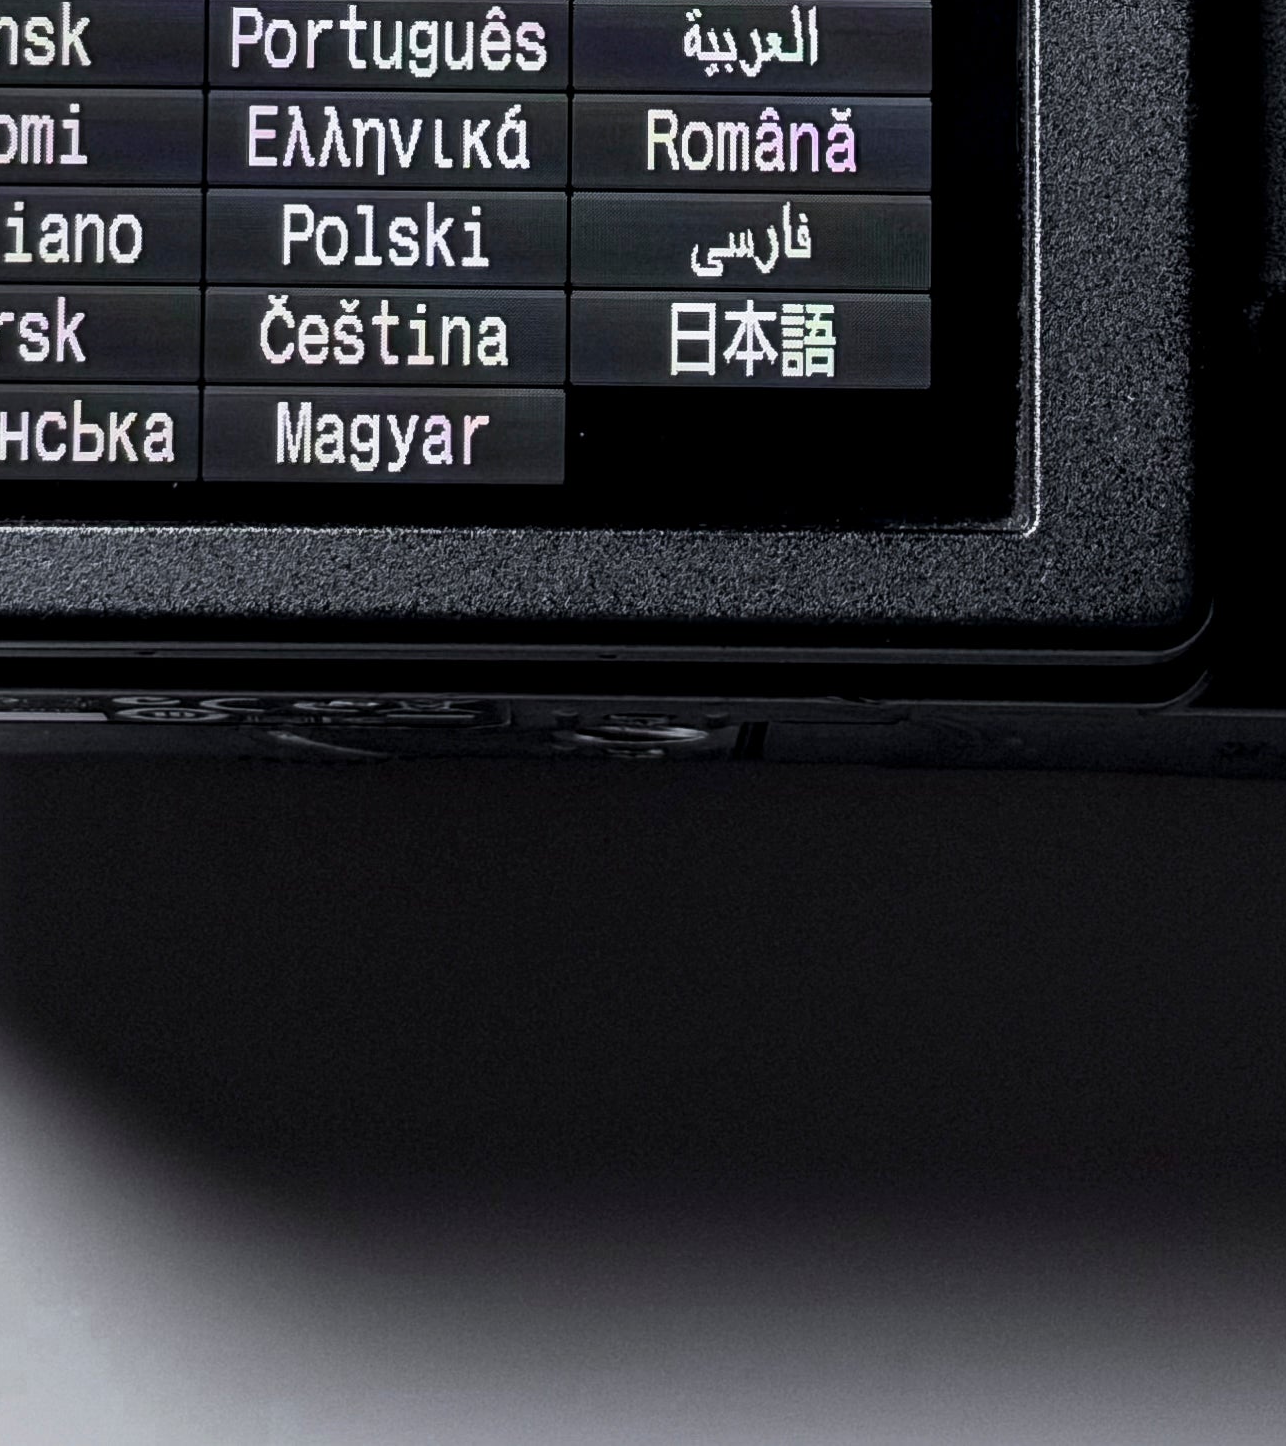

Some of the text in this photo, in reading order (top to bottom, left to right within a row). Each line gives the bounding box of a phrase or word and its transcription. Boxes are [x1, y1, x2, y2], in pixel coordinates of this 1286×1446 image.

[231, 4, 548, 78] Português
[683, 4, 819, 78] العربية
[248, 103, 531, 176] Ελληνικά
[646, 106, 857, 173] Română
[281, 201, 490, 268] Polski
[259, 294, 509, 367] Čeština
[670, 299, 837, 378] 日本語
[276, 401, 490, 473] Magyar
